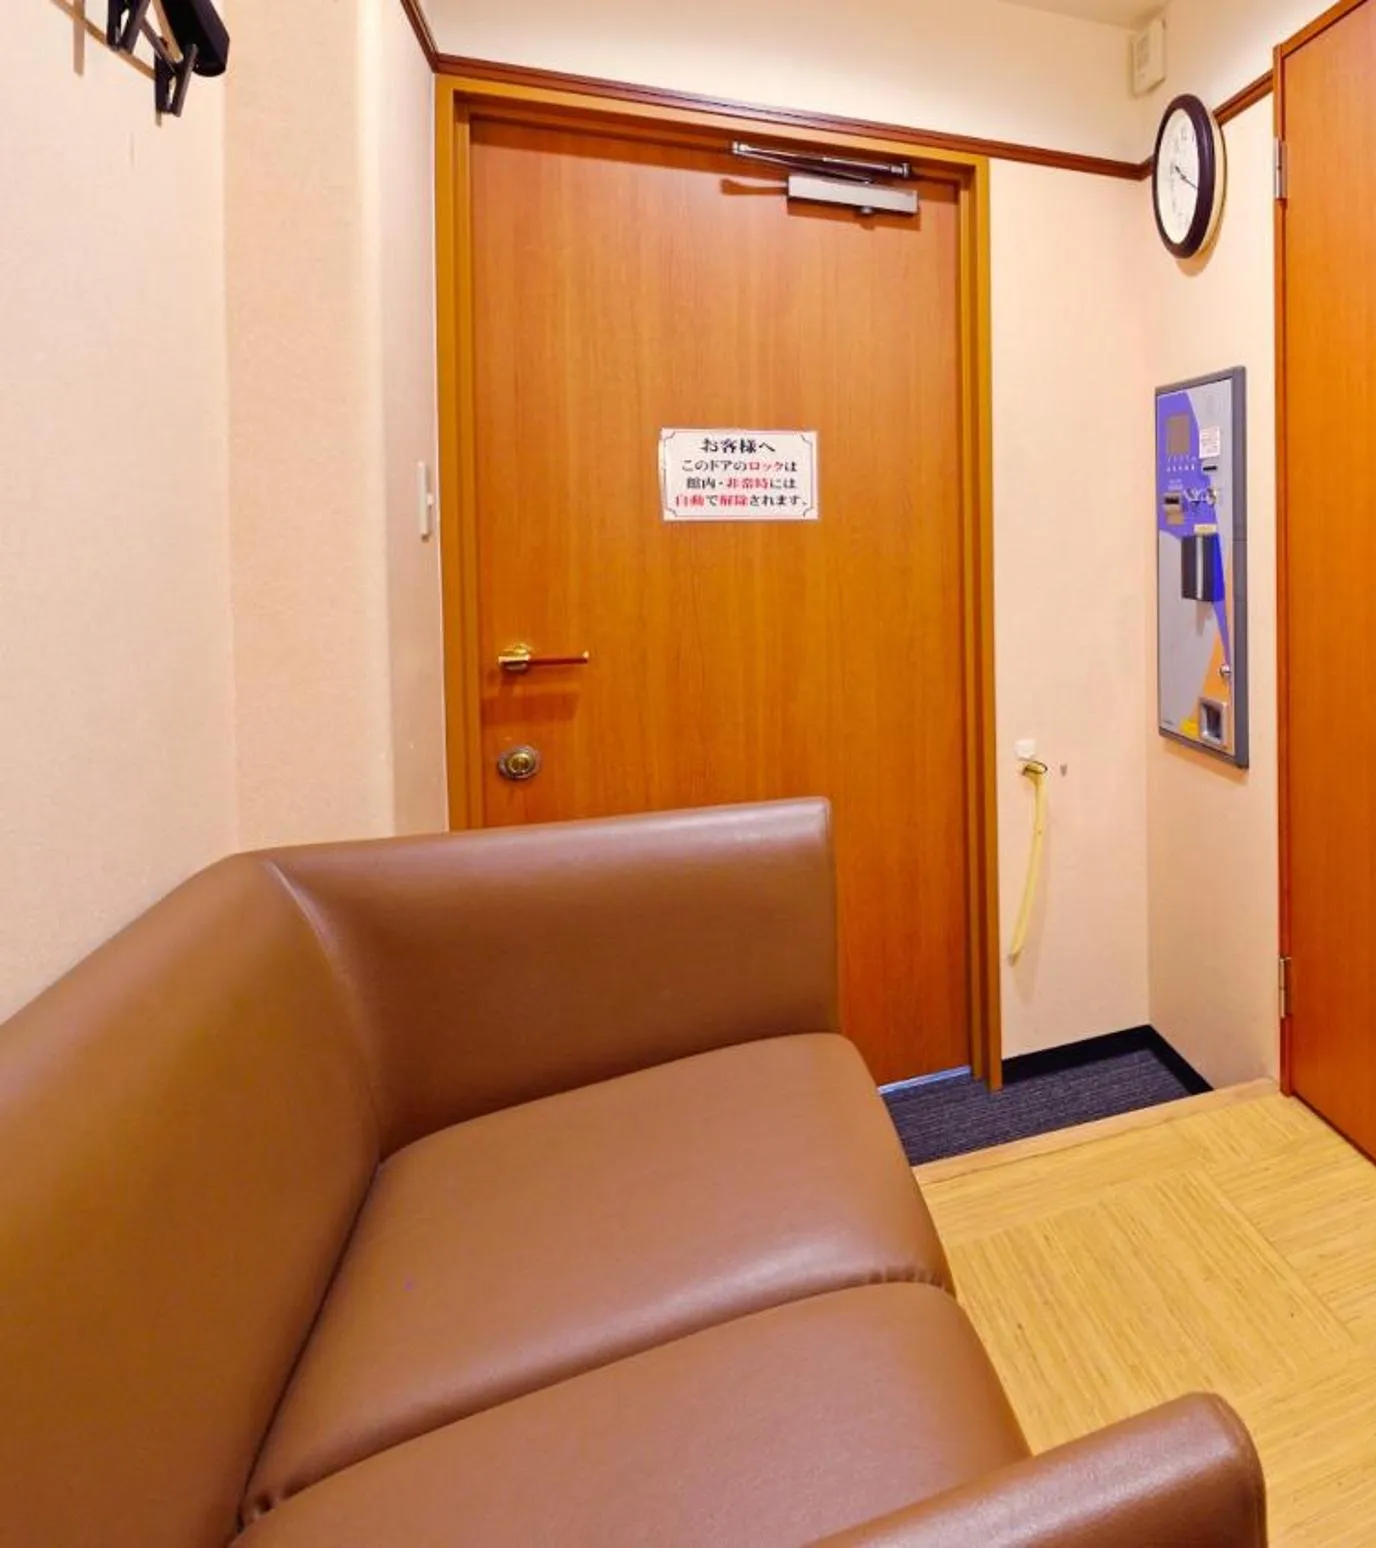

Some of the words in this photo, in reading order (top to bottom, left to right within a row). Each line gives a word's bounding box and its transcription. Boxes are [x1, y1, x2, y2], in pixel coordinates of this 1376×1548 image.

[700, 438, 776, 453] お客様へ
[682, 459, 797, 472] このドアのロックは
